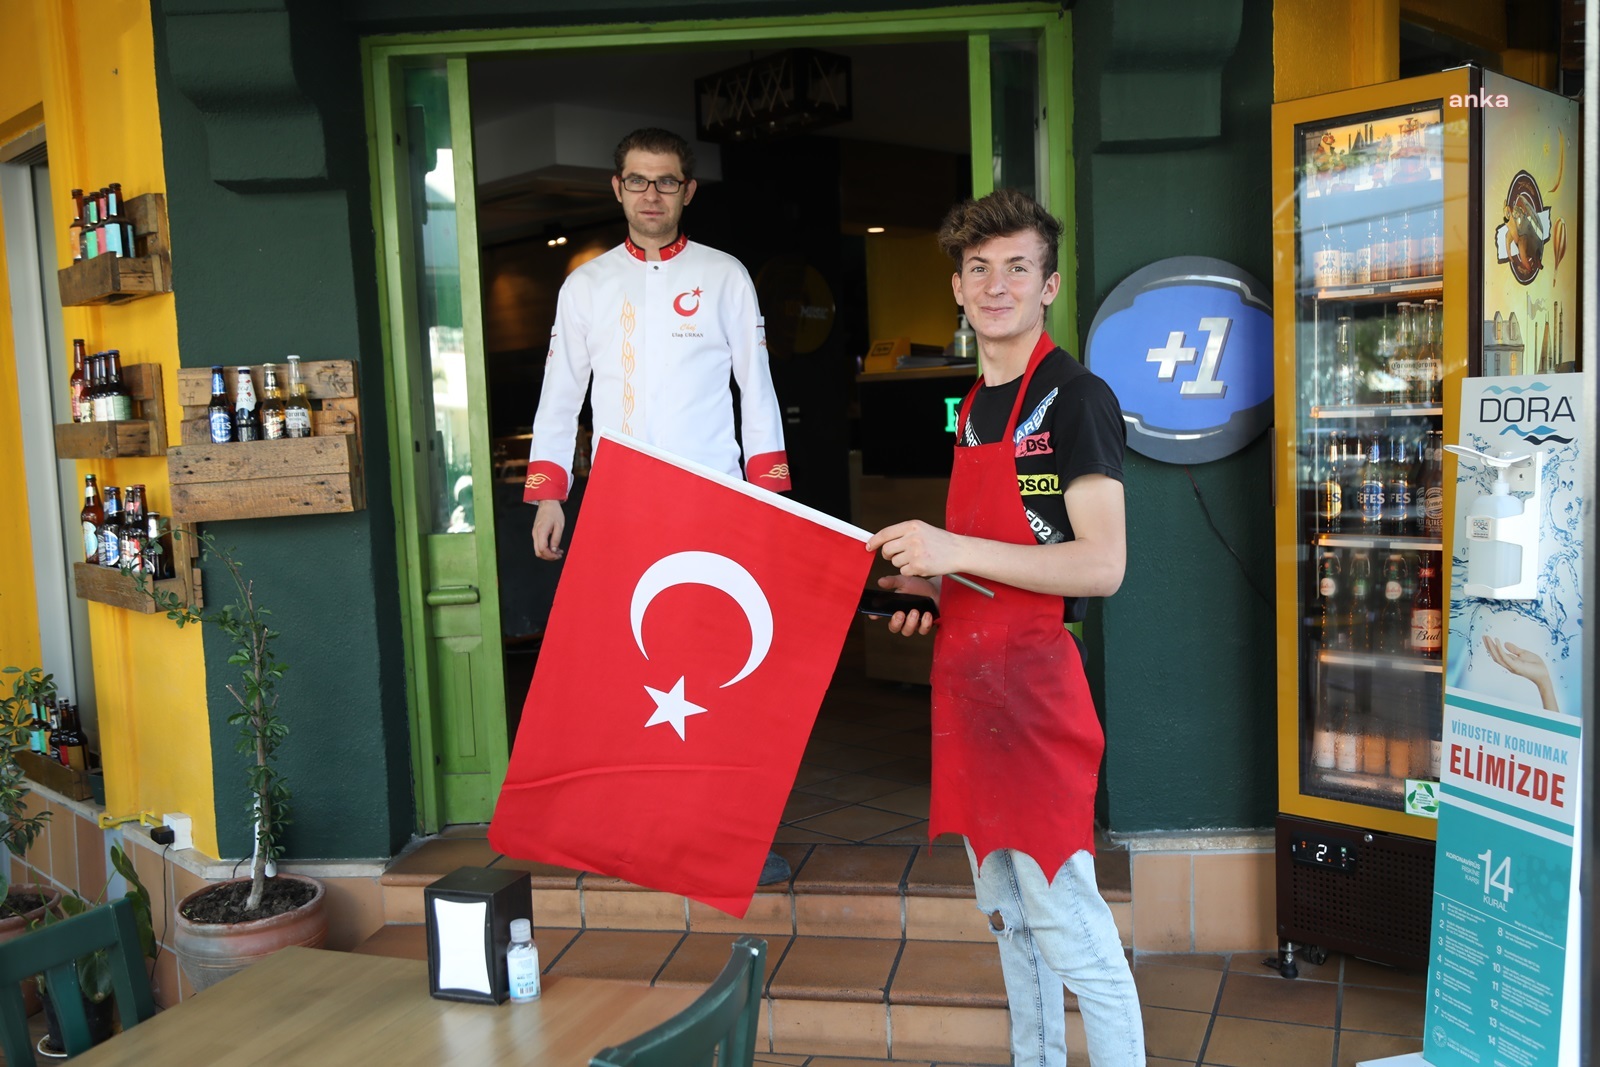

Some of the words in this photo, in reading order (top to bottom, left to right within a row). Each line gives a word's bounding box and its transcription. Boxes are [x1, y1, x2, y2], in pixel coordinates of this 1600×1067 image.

[1145, 316, 1234, 400] +1
[1480, 396, 1576, 423] DORA
[212, 422, 231, 430] EFES
[1359, 493, 1385, 504] EFES
[1390, 492, 1411, 504] FES
[1416, 630, 1441, 641] Bud
[1451, 719, 1500, 746] VİRUSTEN
[1504, 734, 1568, 766] KORUNMAK
[1450, 743, 1566, 809] ELİMİZDE
[1316, 843, 1328, 862] 2
[1477, 848, 1514, 903] 14
[1441, 902, 1445, 911] 1
[1483, 894, 1508, 913] KURAL
[1439, 919, 1445, 928] 2
[1497, 926, 1503, 937] 8
[1438, 936, 1444, 946] 3
[1496, 945, 1502, 955] 9
[1437, 954, 1442, 963] 4
[1492, 962, 1501, 974] 10
[1436, 971, 1441, 981] 5
[1492, 980, 1499, 991] 11
[1434, 988, 1440, 998] 6
[1434, 1004, 1439, 1014] 7
[1490, 998, 1499, 1010] 12
[1489, 1016, 1498, 1028] 13
[1487, 1034, 1496, 1046] 14
